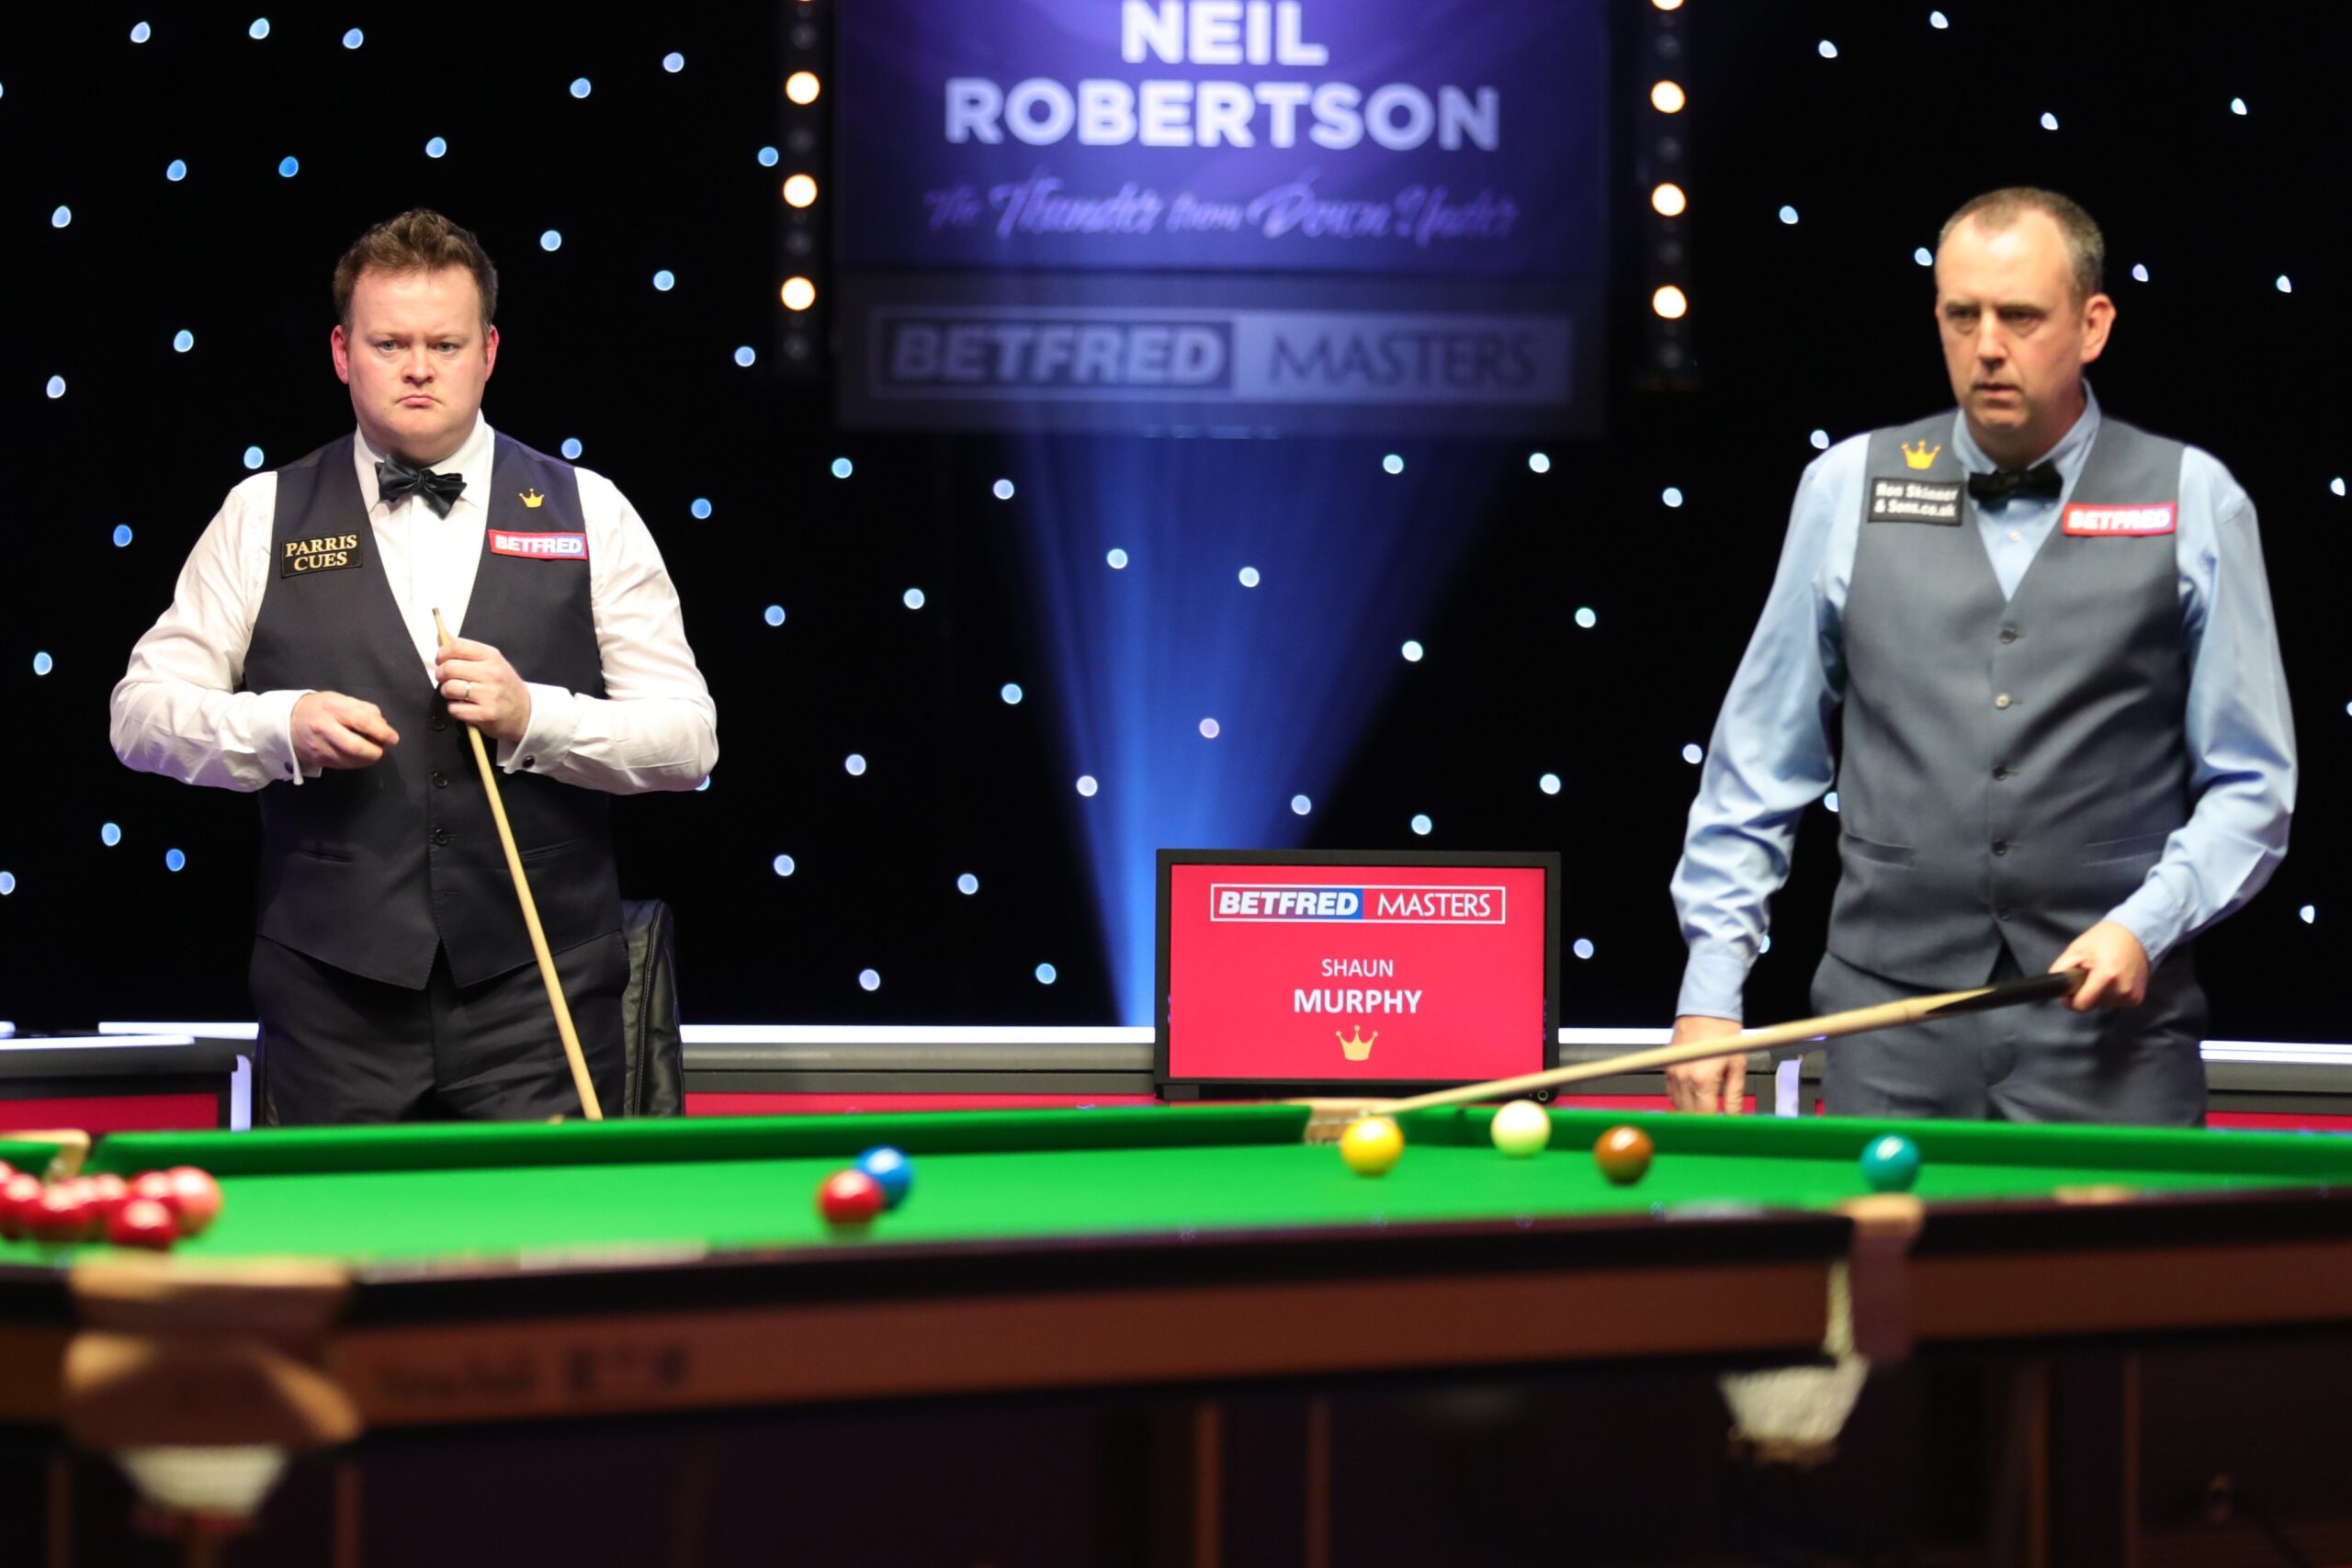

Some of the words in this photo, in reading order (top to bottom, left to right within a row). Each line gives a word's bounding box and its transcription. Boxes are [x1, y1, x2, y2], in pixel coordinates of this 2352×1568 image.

[1122, 0, 1329, 66] NEIL
[945, 77, 1499, 152] ROBERTSON
[889, 325, 1224, 384] BETFRED
[1271, 329, 1537, 388] MASTERS
[2067, 507, 2169, 528] BETFRED
[285, 534, 356, 557] PARRIS
[494, 535, 582, 553] BETFRED
[293, 551, 346, 570] CUES
[1218, 890, 1358, 915] BETFRED
[1377, 893, 1489, 916] MASTERS
[1321, 958, 1393, 976] SHAUN
[1293, 988, 1421, 1013] MURPHY
